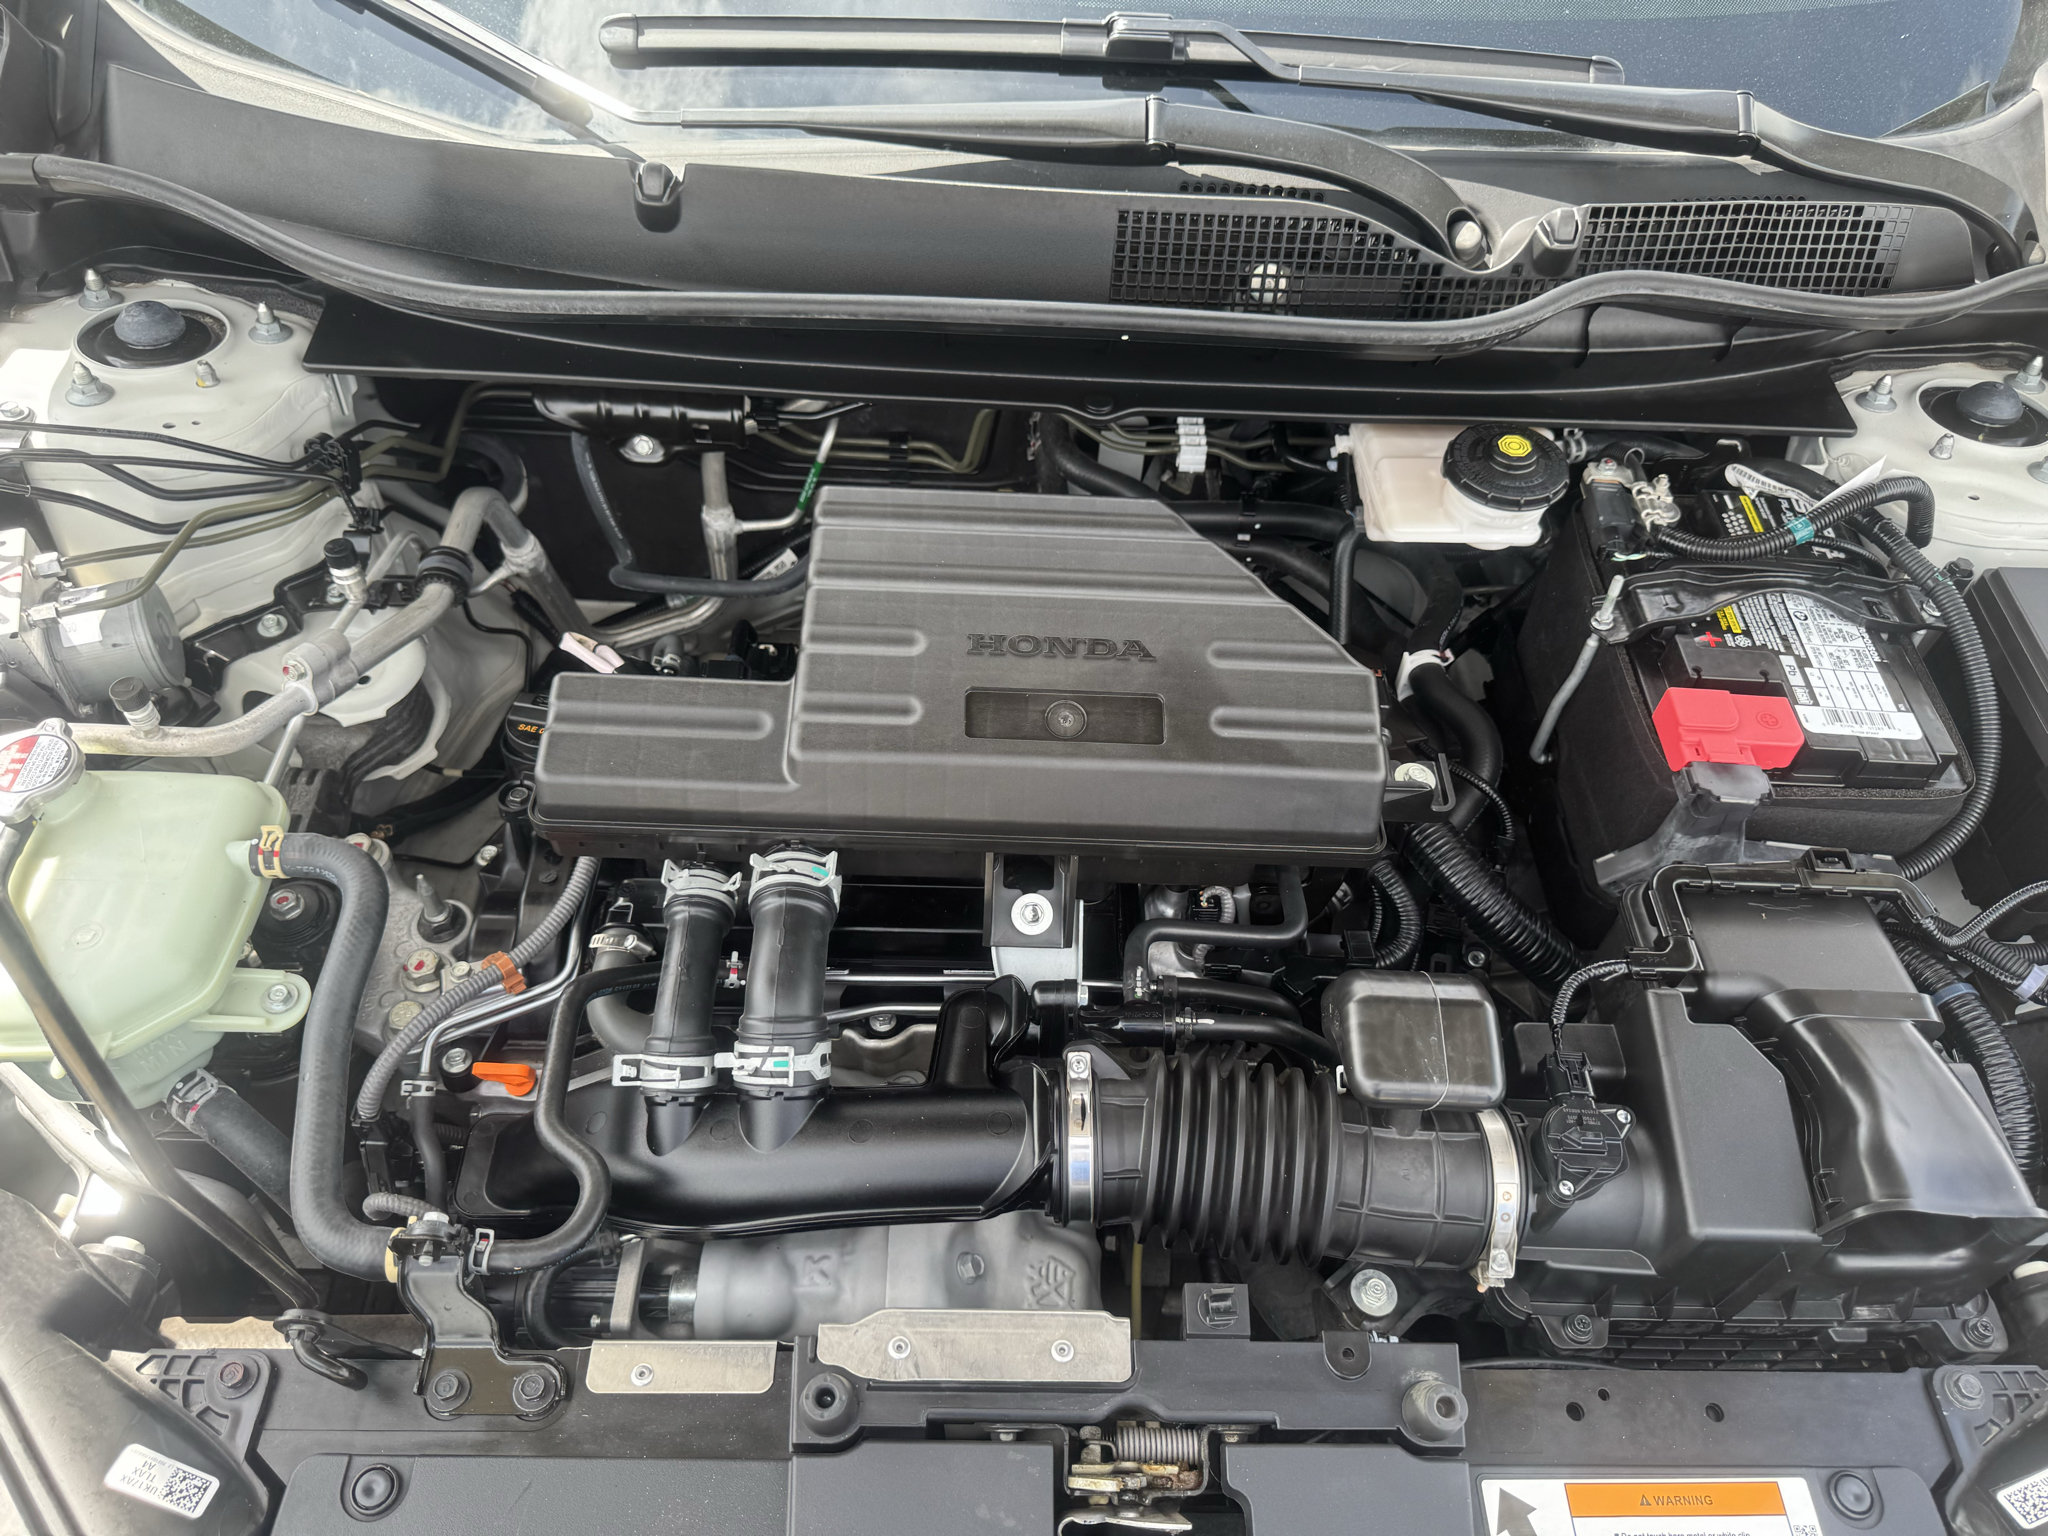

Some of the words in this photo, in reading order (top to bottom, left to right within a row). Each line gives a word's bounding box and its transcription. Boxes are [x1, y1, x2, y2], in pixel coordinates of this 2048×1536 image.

[967, 633, 1157, 662] HONDA
[1785, 664, 1797, 677] Pb
[517, 723, 539, 733] SAE
[1653, 1495, 1714, 1506] WARNING
